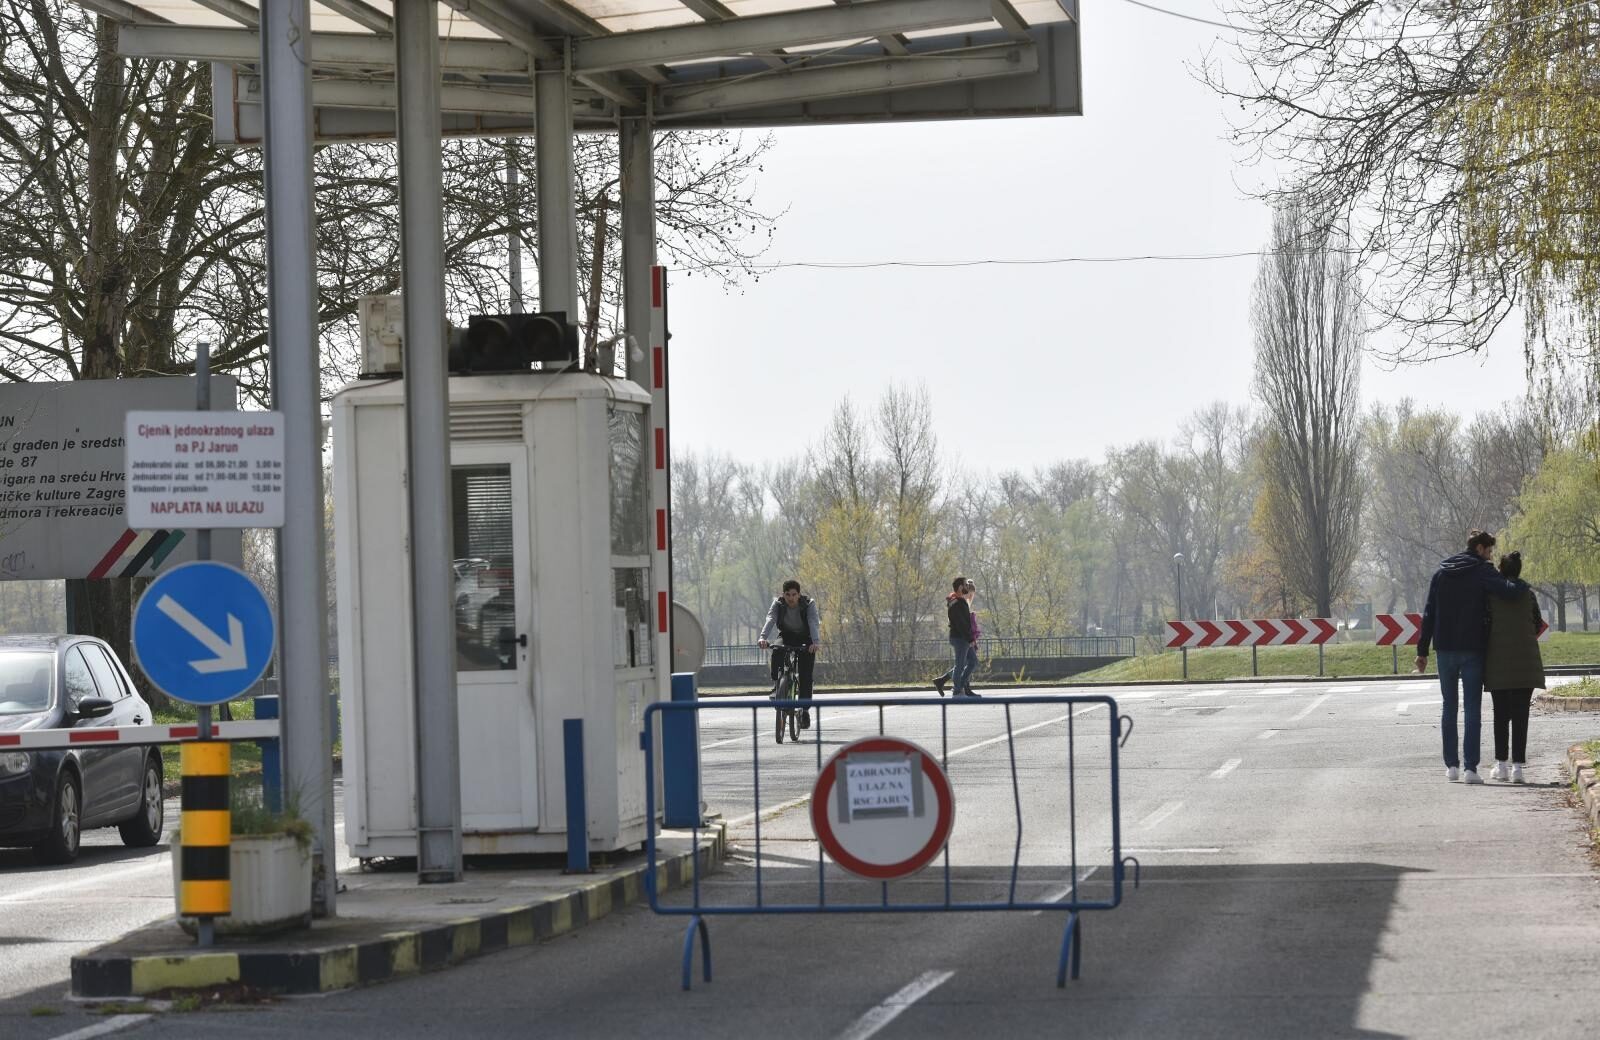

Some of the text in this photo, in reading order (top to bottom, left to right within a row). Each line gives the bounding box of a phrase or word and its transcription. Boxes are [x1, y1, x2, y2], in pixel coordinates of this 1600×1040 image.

[138, 424, 275, 439] Cjenik jednokratnog ulaza
[13, 440, 58, 453] građen
[62, 439, 76, 451] je
[175, 441, 239, 453] na PJ Jarun
[21, 456, 37, 468] 87
[40, 475, 55, 484] na
[60, 471, 96, 483] sreću
[36, 489, 81, 501] kulture
[46, 506, 51, 517] i
[54, 503, 124, 517] rekreacije
[151, 501, 265, 514] NAPLATA NA ULAZU
[850, 767, 910, 777] ZABRANJEN
[858, 781, 904, 791] ULAZ NA
[876, 795, 910, 804] JARUN
